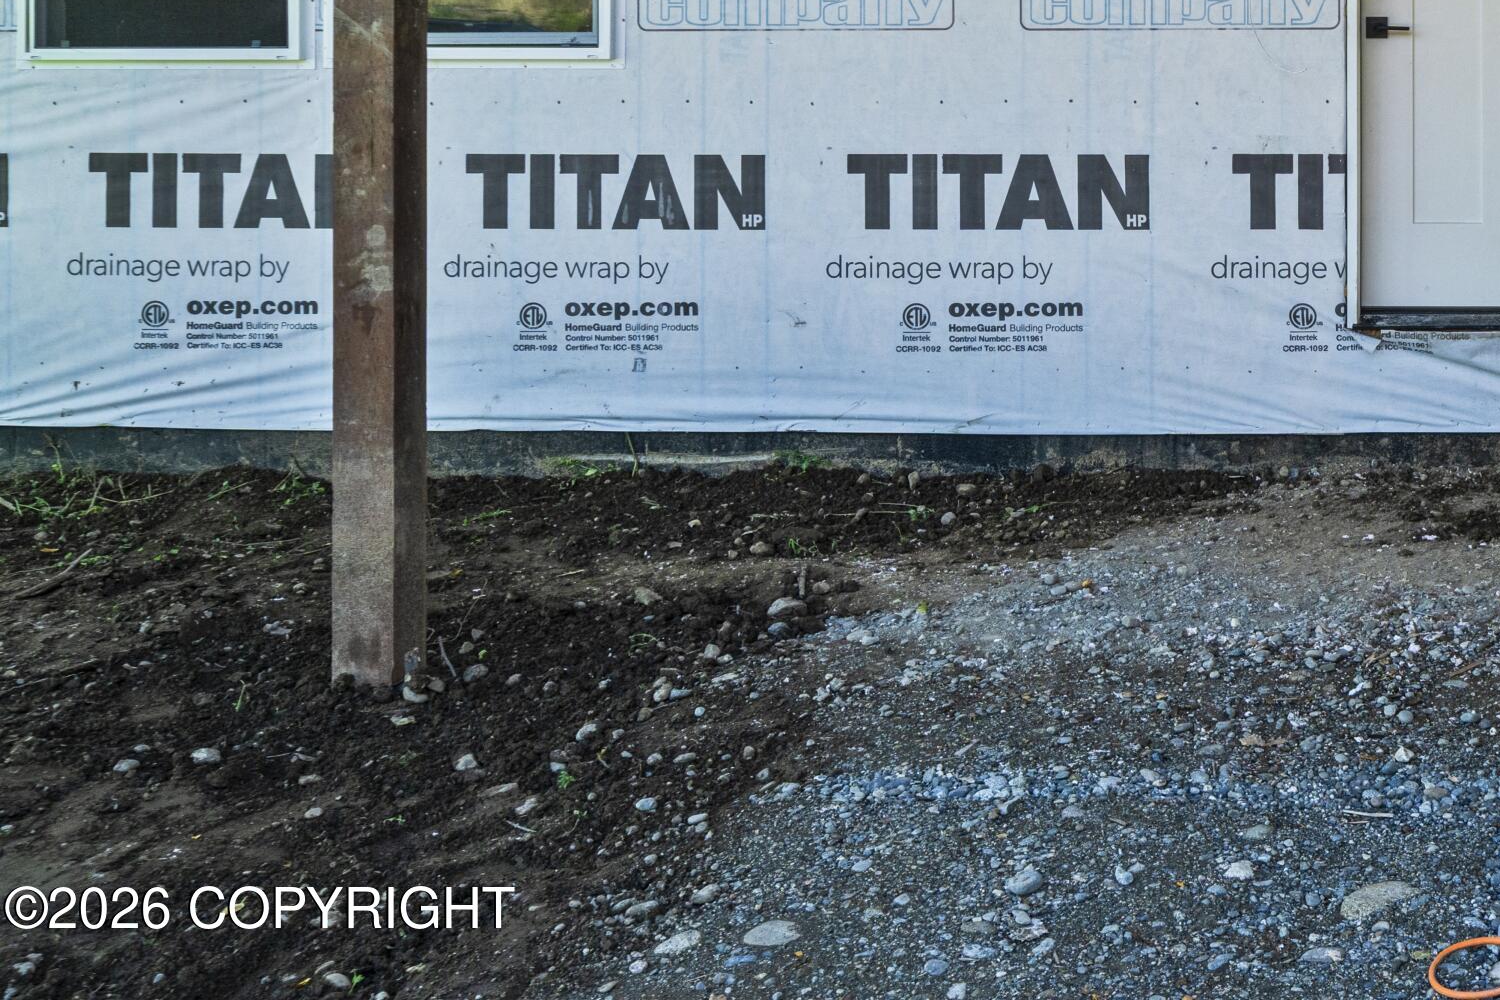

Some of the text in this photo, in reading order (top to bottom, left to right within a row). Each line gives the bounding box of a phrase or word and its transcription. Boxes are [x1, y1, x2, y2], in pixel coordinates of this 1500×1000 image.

[88, 152, 333, 229] TITA
[465, 153, 766, 230] TITAN
[847, 153, 1150, 231] TITAN
[742, 214, 763, 227] HP
[1126, 214, 1147, 227] HP
[67, 252, 290, 284] drainage wrap by
[443, 254, 669, 285] drainage wrap by
[826, 255, 1053, 285] drainage wrap by
[1211, 255, 1327, 285] drainage
[186, 299, 318, 318] oxep.com
[565, 301, 699, 320] oxep.com
[948, 302, 1083, 321] oxep.com
[186, 322, 318, 331] HomeGuard Building Products
[565, 323, 699, 333] HomeGuard Building Products
[949, 324, 1083, 334] HomeGuard Building Products
[519, 333, 547, 341] Intertek
[902, 334, 931, 342] Intertek
[949, 335, 977, 343] Control
[1012, 335, 1043, 343] 5011961
